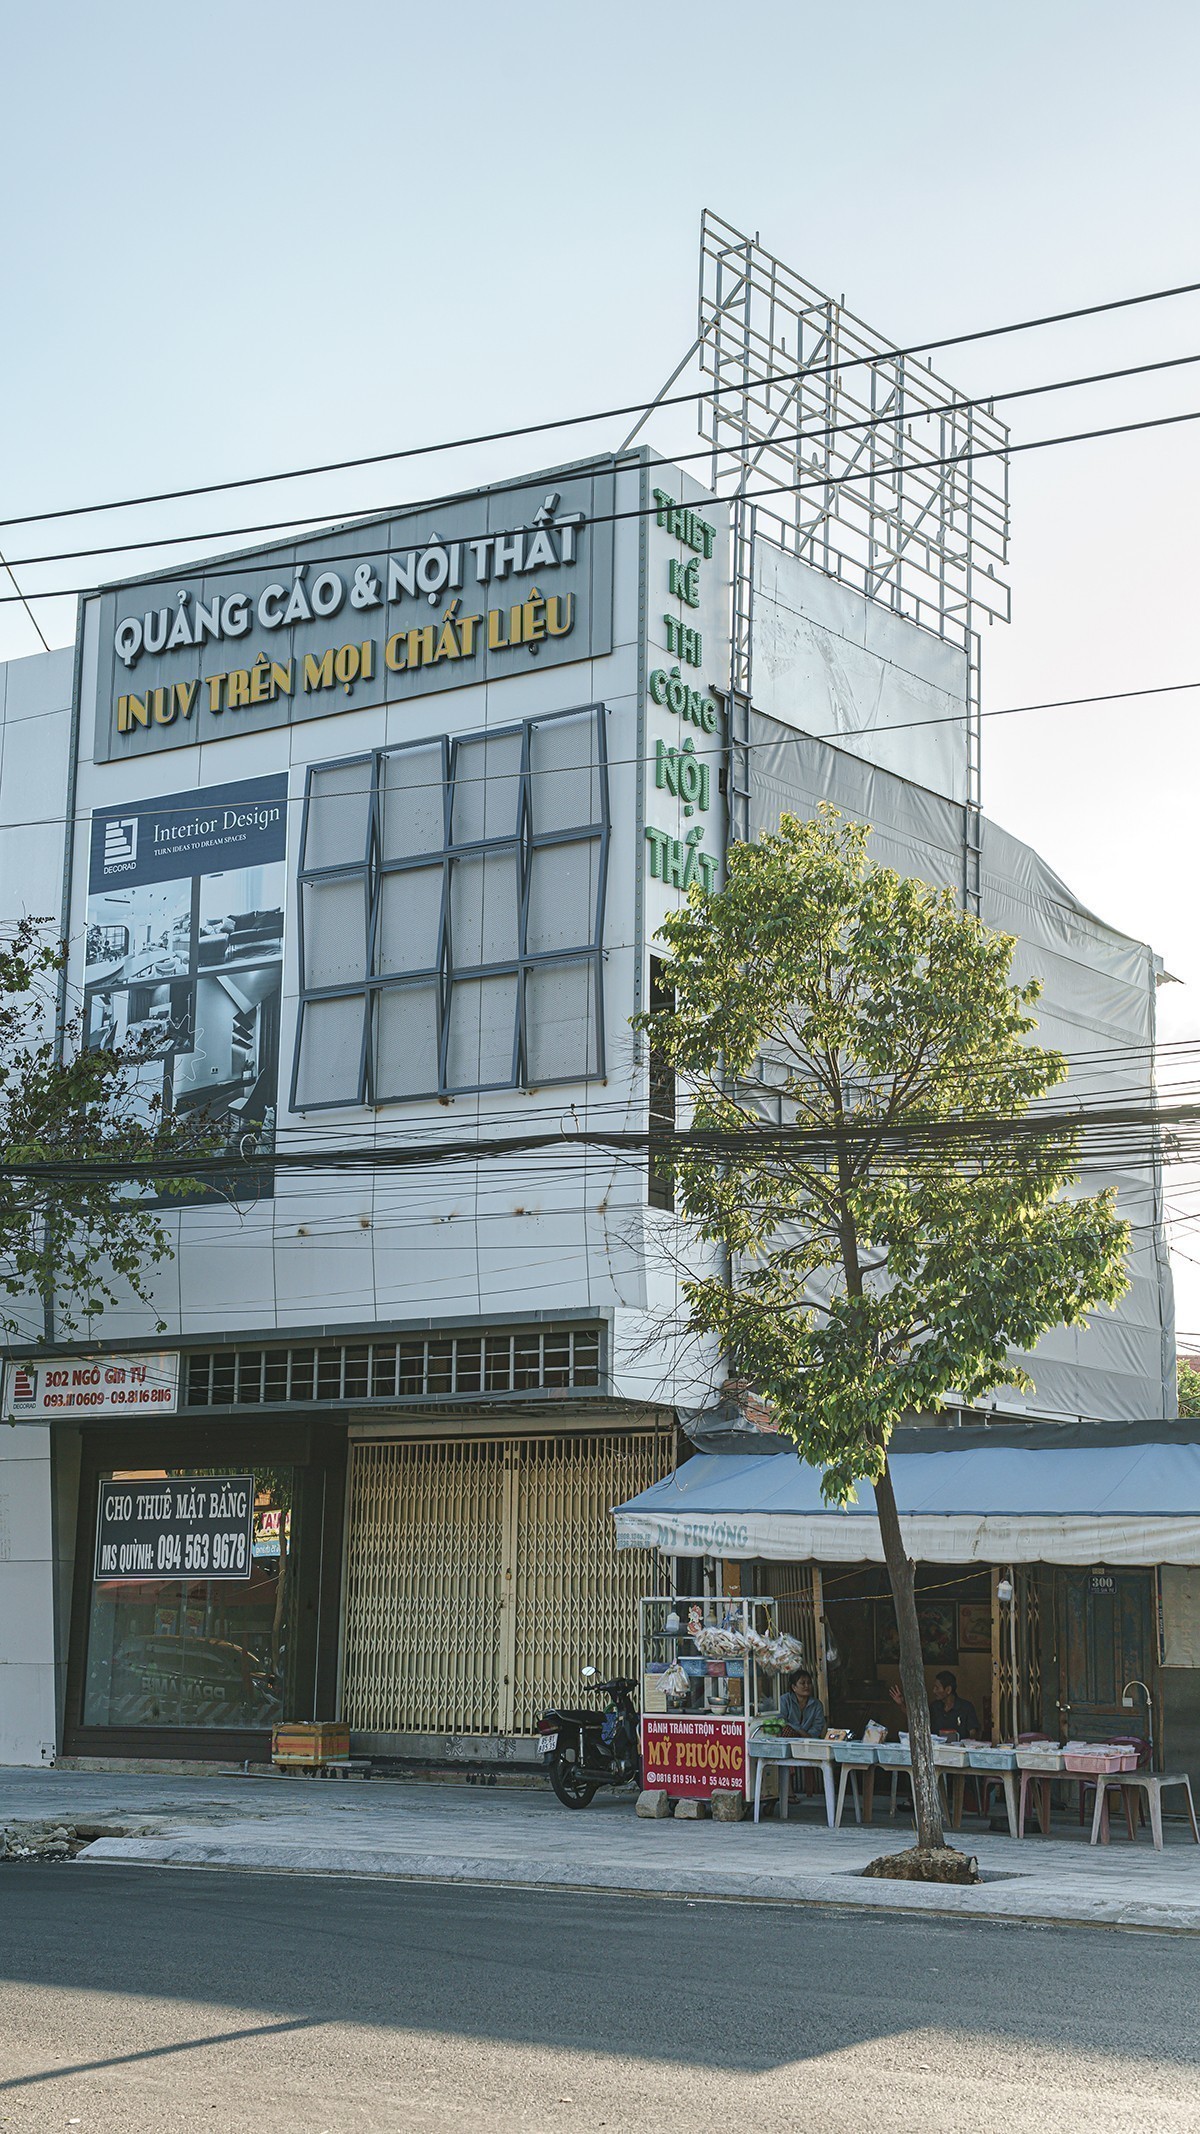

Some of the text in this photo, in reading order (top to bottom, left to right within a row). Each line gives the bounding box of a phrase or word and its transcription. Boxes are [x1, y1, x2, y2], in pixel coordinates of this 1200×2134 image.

[114, 493, 585, 668] QUẢNG CÁO & NỘI THẤT
[669, 557, 701, 608] KẾ
[118, 586, 576, 733] IN UV TRÊN MỌI CHẤT LIỆU
[664, 614, 702, 668] THI
[650, 666, 718, 734] CÔNG
[656, 737, 710, 817] NỘI
[153, 806, 280, 843] Interior Design
[153, 833, 247, 856] TURN IDEAS TO DREAM SPACES
[645, 826, 719, 895] THẤT
[103, 862, 137, 875] DECORAD
[45, 1370, 69, 1388] 302
[72, 1365, 101, 1386] NGÔ
[130, 1365, 147, 1386] TỰ
[76, 1392, 105, 1406] 0609
[105, 1482, 247, 1525] CHO THUÊ MẶT BẰNG
[101, 1544, 118, 1570] MS
[119, 1538, 154, 1573] QUỲNH:
[157, 1534, 182, 1570] 094
[184, 1533, 210, 1570] 563
[212, 1532, 246, 1569] 9678
[656, 1517, 749, 1553] MỸ PHƯỢNG
[1091, 1577, 1113, 1588] 300
[647, 1720, 668, 1734] BÁNH
[669, 1721, 694, 1734] TRÁNG
[695, 1722, 715, 1736] TRỘN
[648, 1735, 743, 1774] MỸ PHƯỢNG
[656, 1773, 671, 1783] 0816
[672, 1774, 684, 1784] 819
[685, 1774, 697, 1784] 514
[718, 1776, 730, 1787] 424
[731, 1777, 743, 1788] 592
